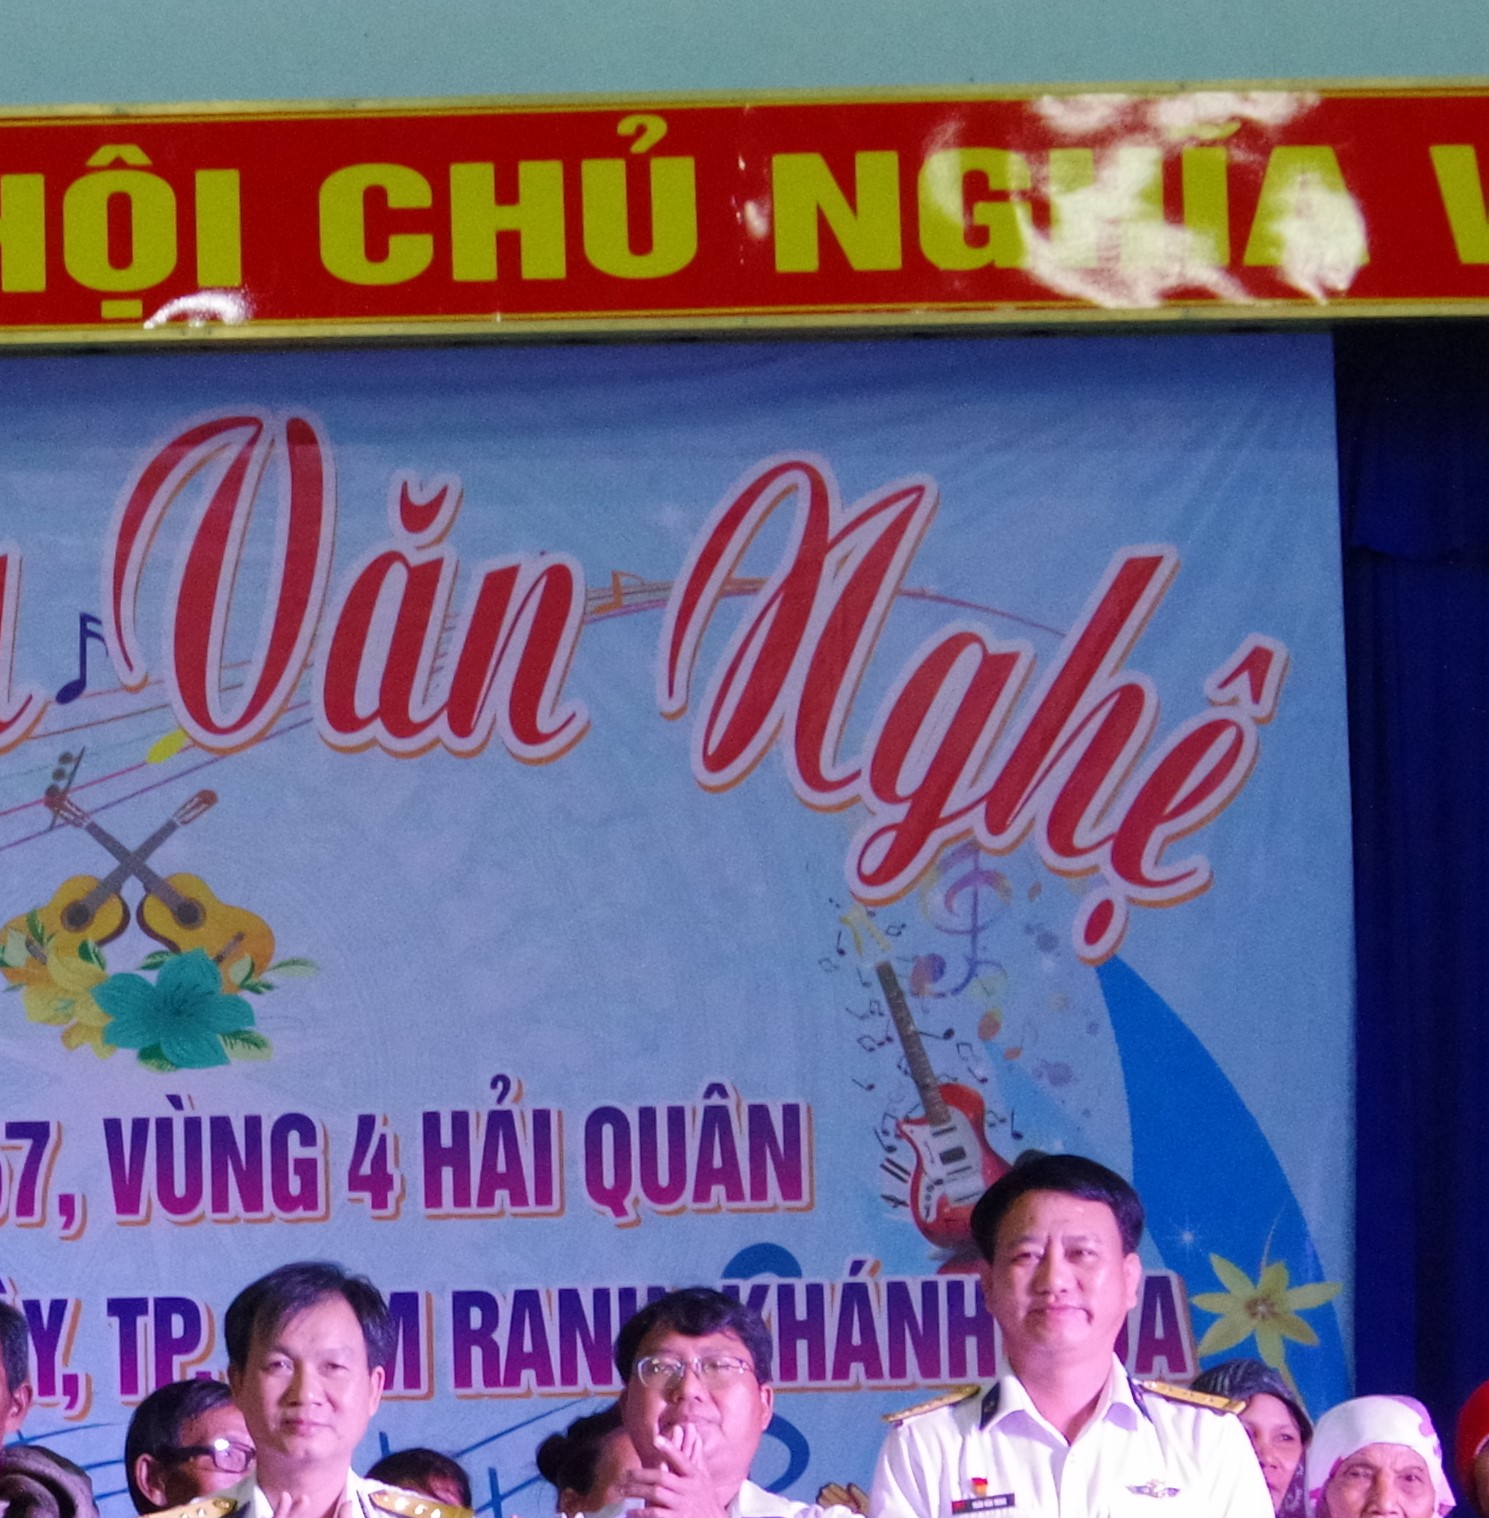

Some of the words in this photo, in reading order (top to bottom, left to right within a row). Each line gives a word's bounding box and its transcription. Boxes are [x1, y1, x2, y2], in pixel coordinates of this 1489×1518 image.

[318, 114, 698, 285] CHỦ
[771, 120, 1370, 282] NGHĨA
[110, 414, 584, 746] Văn
[664, 459, 1275, 951] Nghệ
[102, 1093, 319, 1215] VÙNG
[347, 1112, 395, 1212] 4
[422, 1073, 561, 1211] HẢI
[584, 1082, 804, 1218] QUÂN
